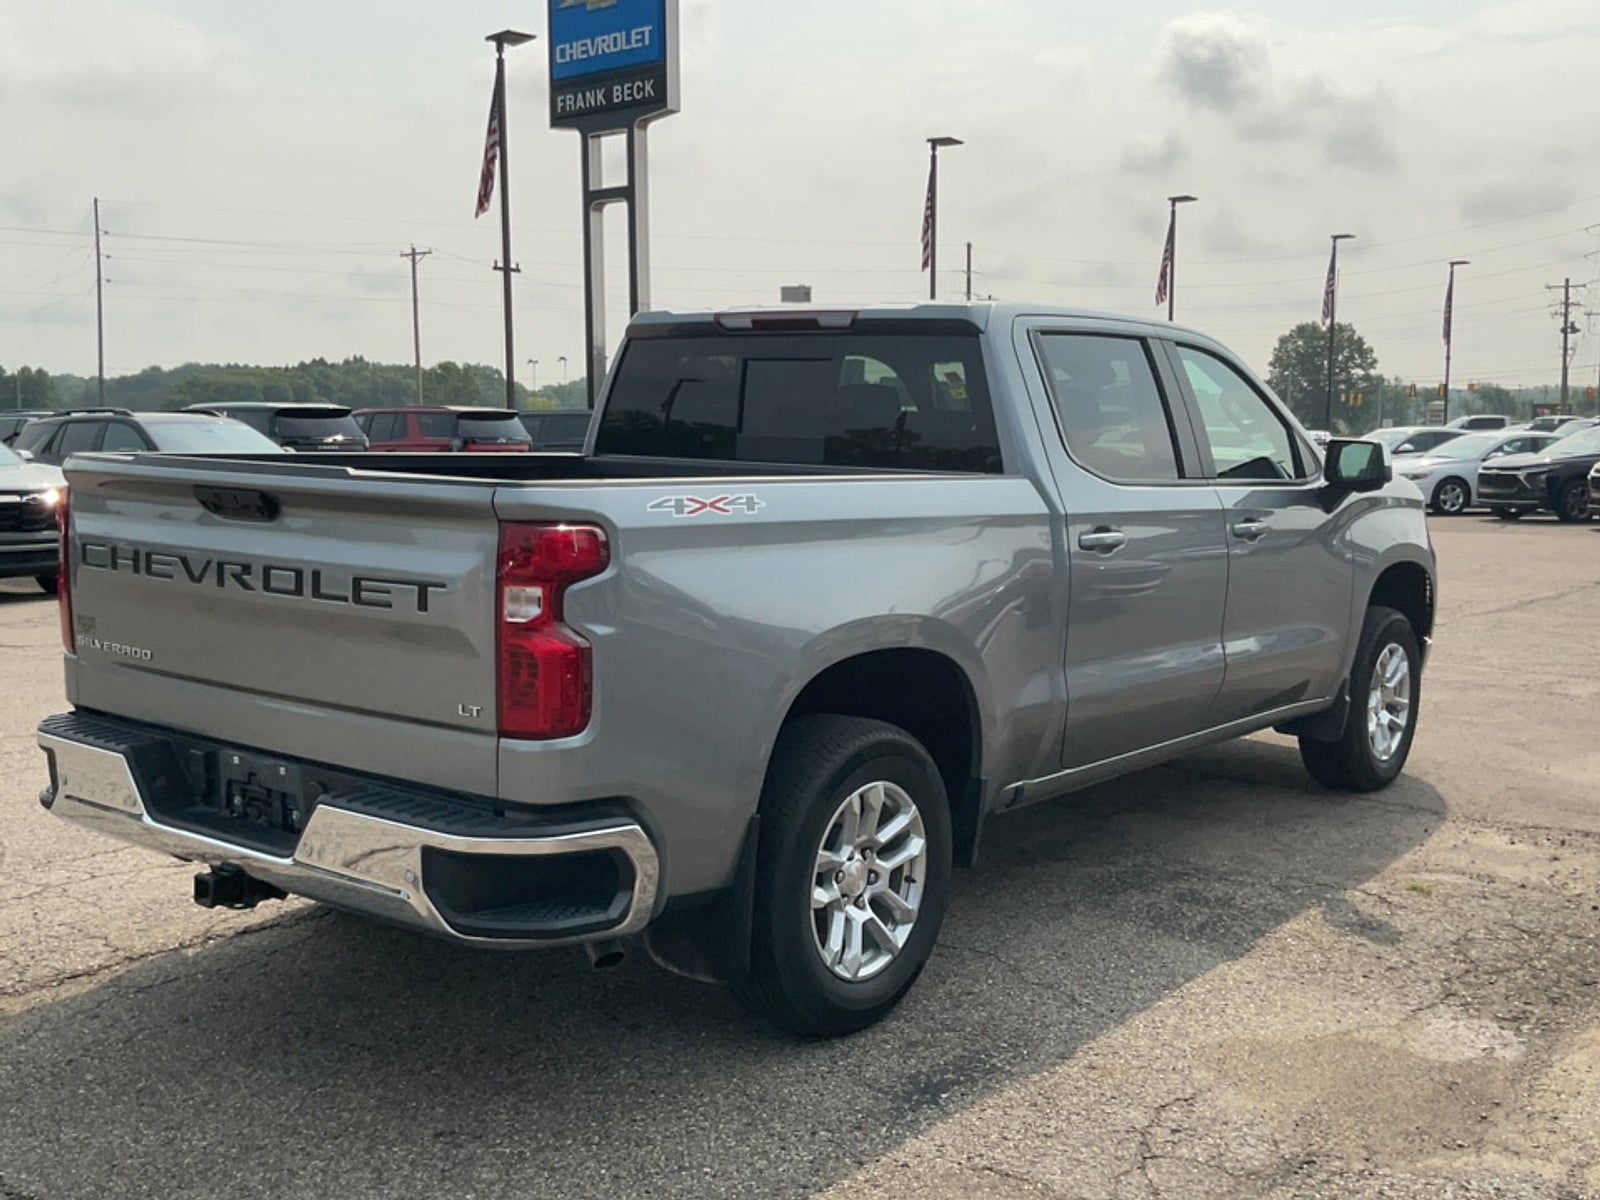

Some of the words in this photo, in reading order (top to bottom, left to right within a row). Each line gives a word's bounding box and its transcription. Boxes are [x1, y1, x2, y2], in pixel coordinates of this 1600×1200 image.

[556, 26, 653, 64] CHEVROLET
[556, 88, 607, 113] FRANK
[613, 79, 655, 103] BECK
[81, 542, 447, 613] CHEVROLET
[77, 634, 153, 661] SILVERADO
[458, 703, 481, 718] LT
